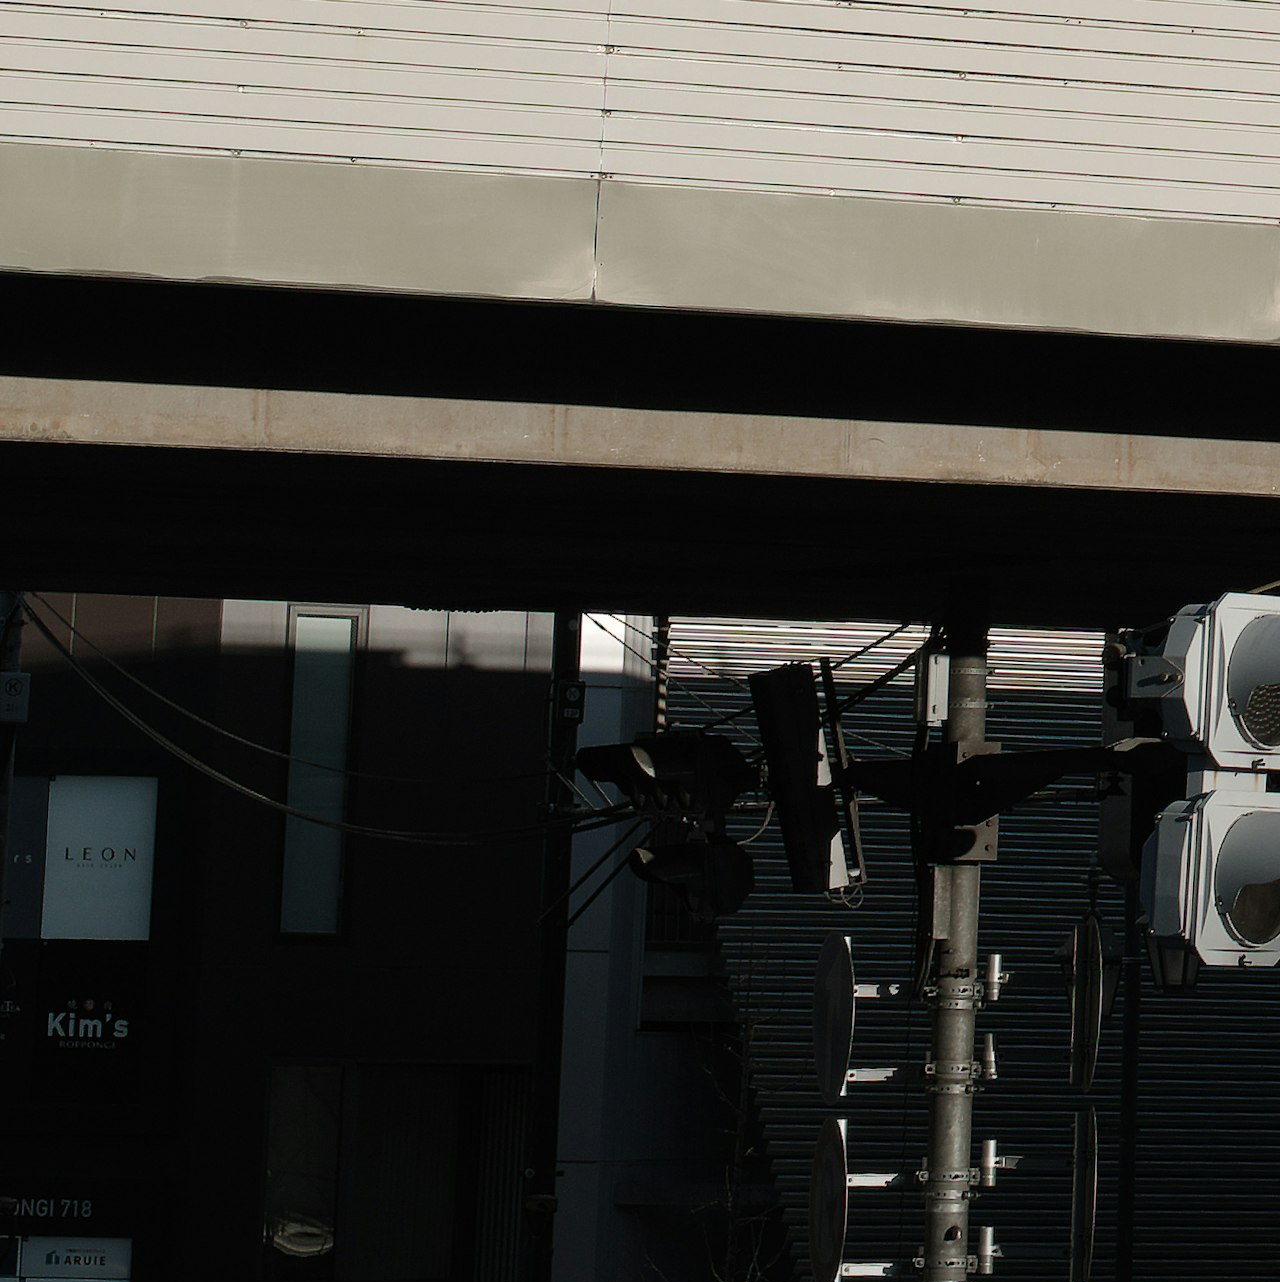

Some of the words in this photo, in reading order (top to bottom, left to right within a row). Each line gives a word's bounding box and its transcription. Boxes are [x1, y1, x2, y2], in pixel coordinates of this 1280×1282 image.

[65, 848, 136, 862] LEON
[47, 1012, 129, 1038] Kim's
[58, 1040, 117, 1049] ROPPONGI
[60, 1199, 93, 1218] 718
[64, 1255, 106, 1266] ARUIE
